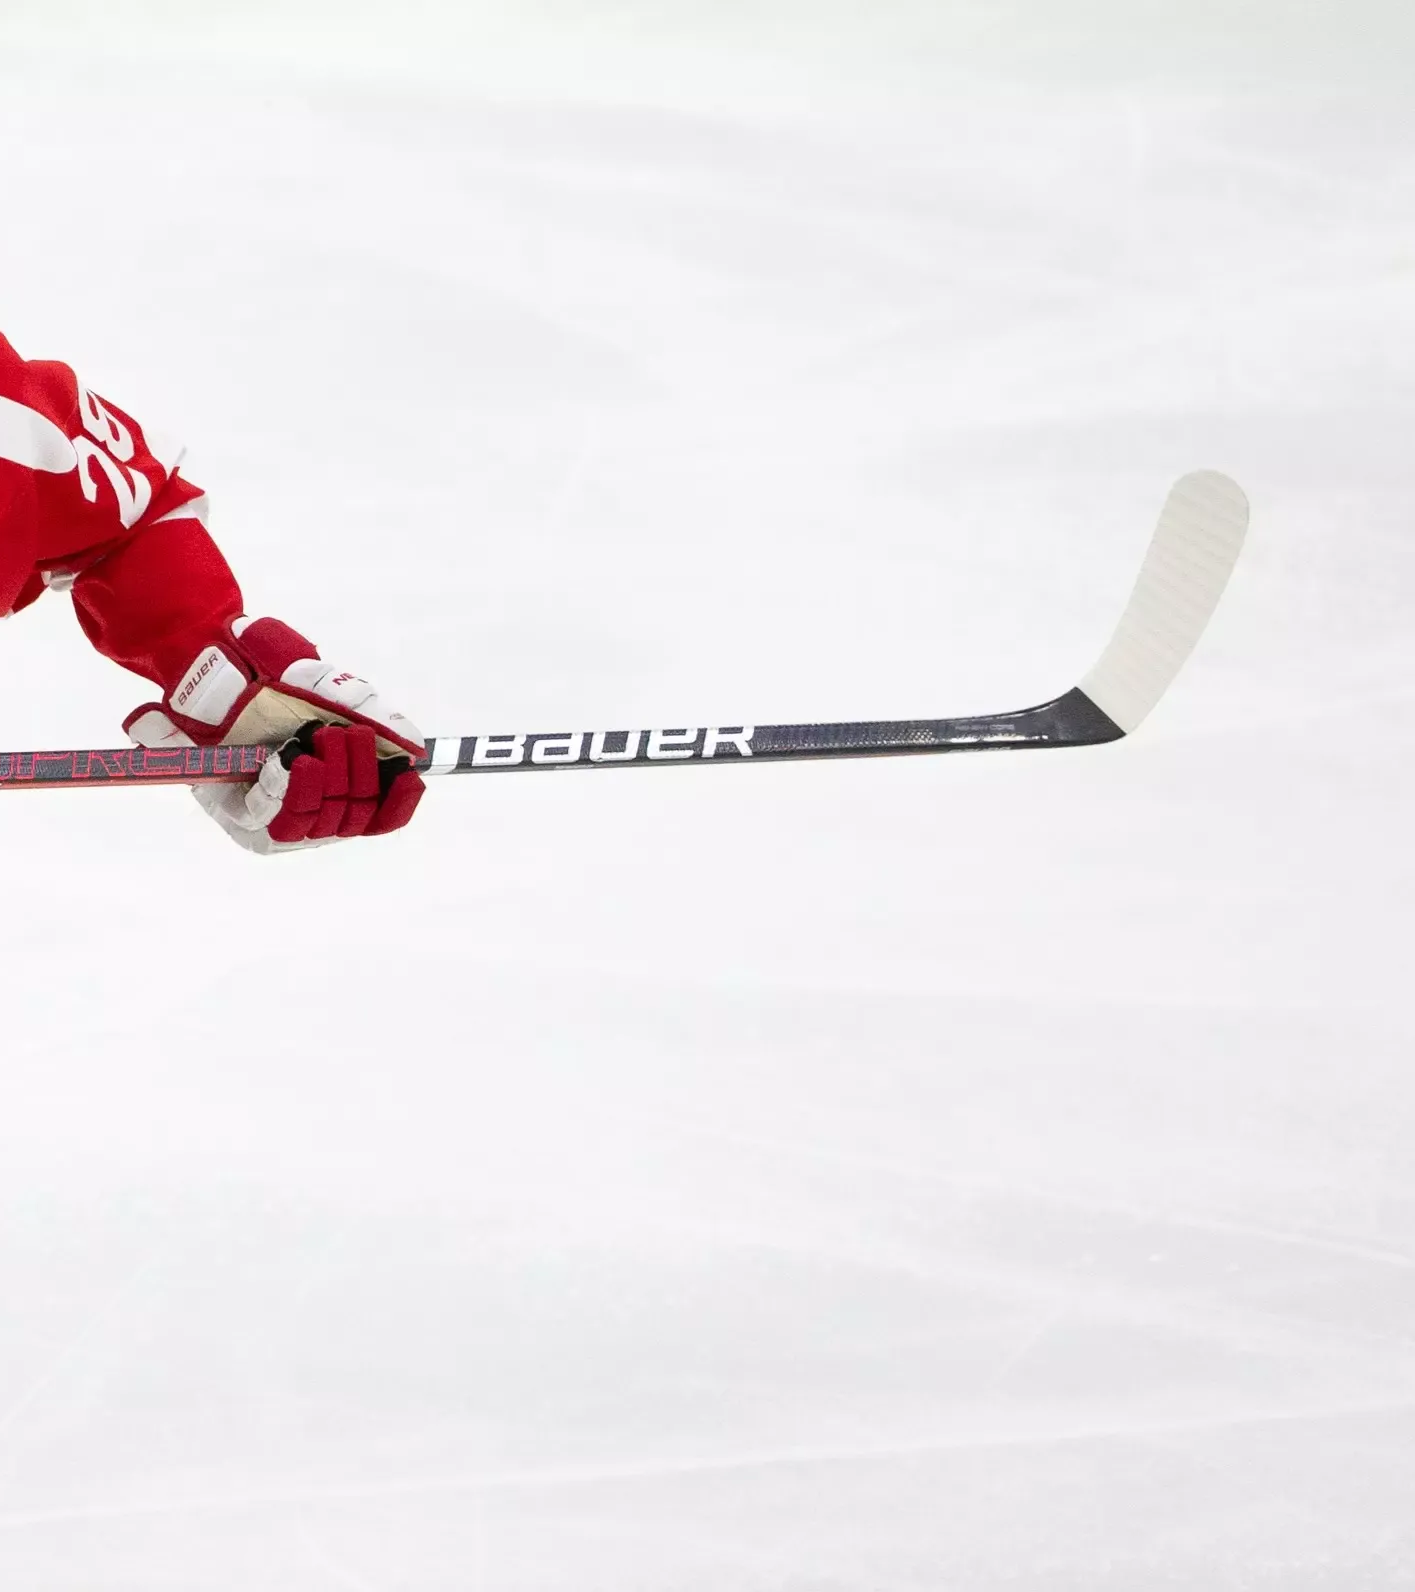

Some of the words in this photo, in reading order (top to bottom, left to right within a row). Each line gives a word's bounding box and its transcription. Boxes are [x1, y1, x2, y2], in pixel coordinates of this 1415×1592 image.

[72, 380, 152, 530] 28
[178, 653, 218, 706] BAUER
[472, 726, 755, 766] BAUER
